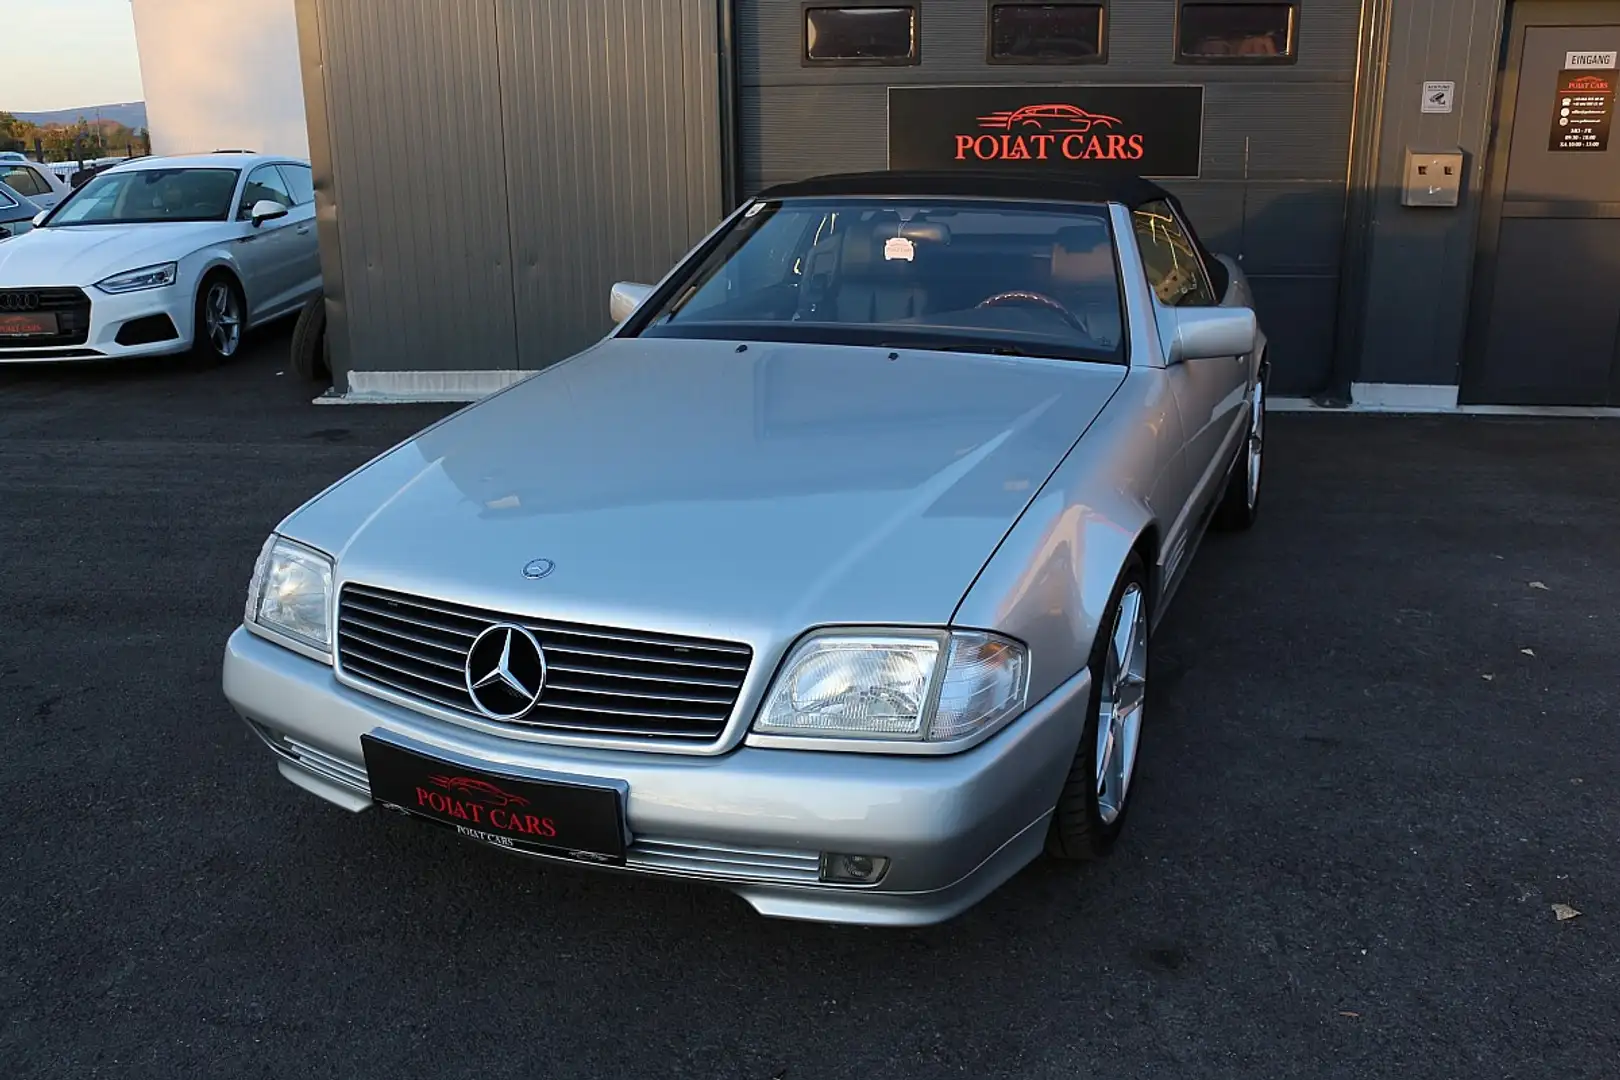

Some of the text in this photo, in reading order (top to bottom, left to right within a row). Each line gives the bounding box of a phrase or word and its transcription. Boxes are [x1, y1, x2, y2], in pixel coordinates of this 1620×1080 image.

[1571, 55, 1610, 65] EINGANG
[954, 134, 1144, 160] POLAT CARS
[415, 786, 557, 837] POLAT CARS
[487, 834, 514, 847] CARS
